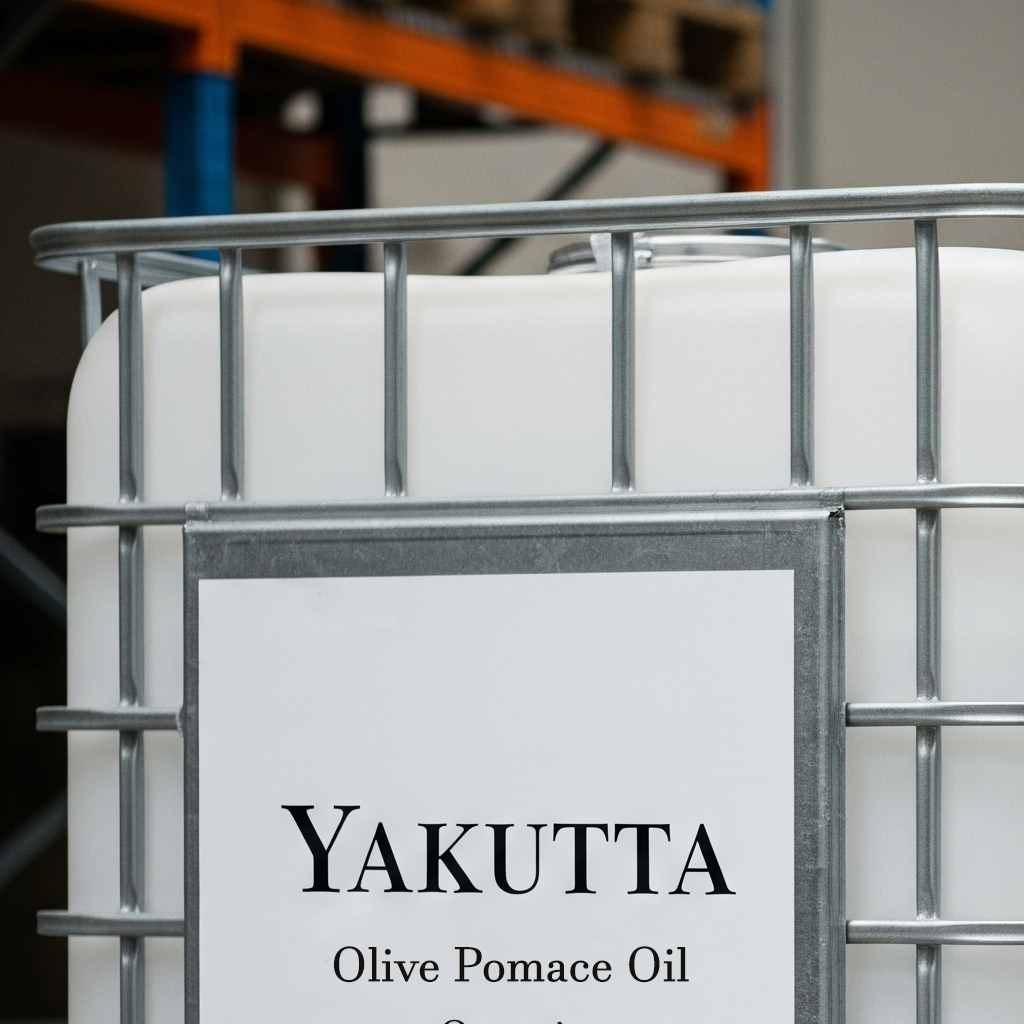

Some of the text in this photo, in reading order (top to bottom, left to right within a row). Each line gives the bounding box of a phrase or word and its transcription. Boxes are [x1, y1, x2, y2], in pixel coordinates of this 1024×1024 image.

[280, 804, 737, 896] YAKUTTA
[333, 945, 690, 983] Olive Pomace Oil
